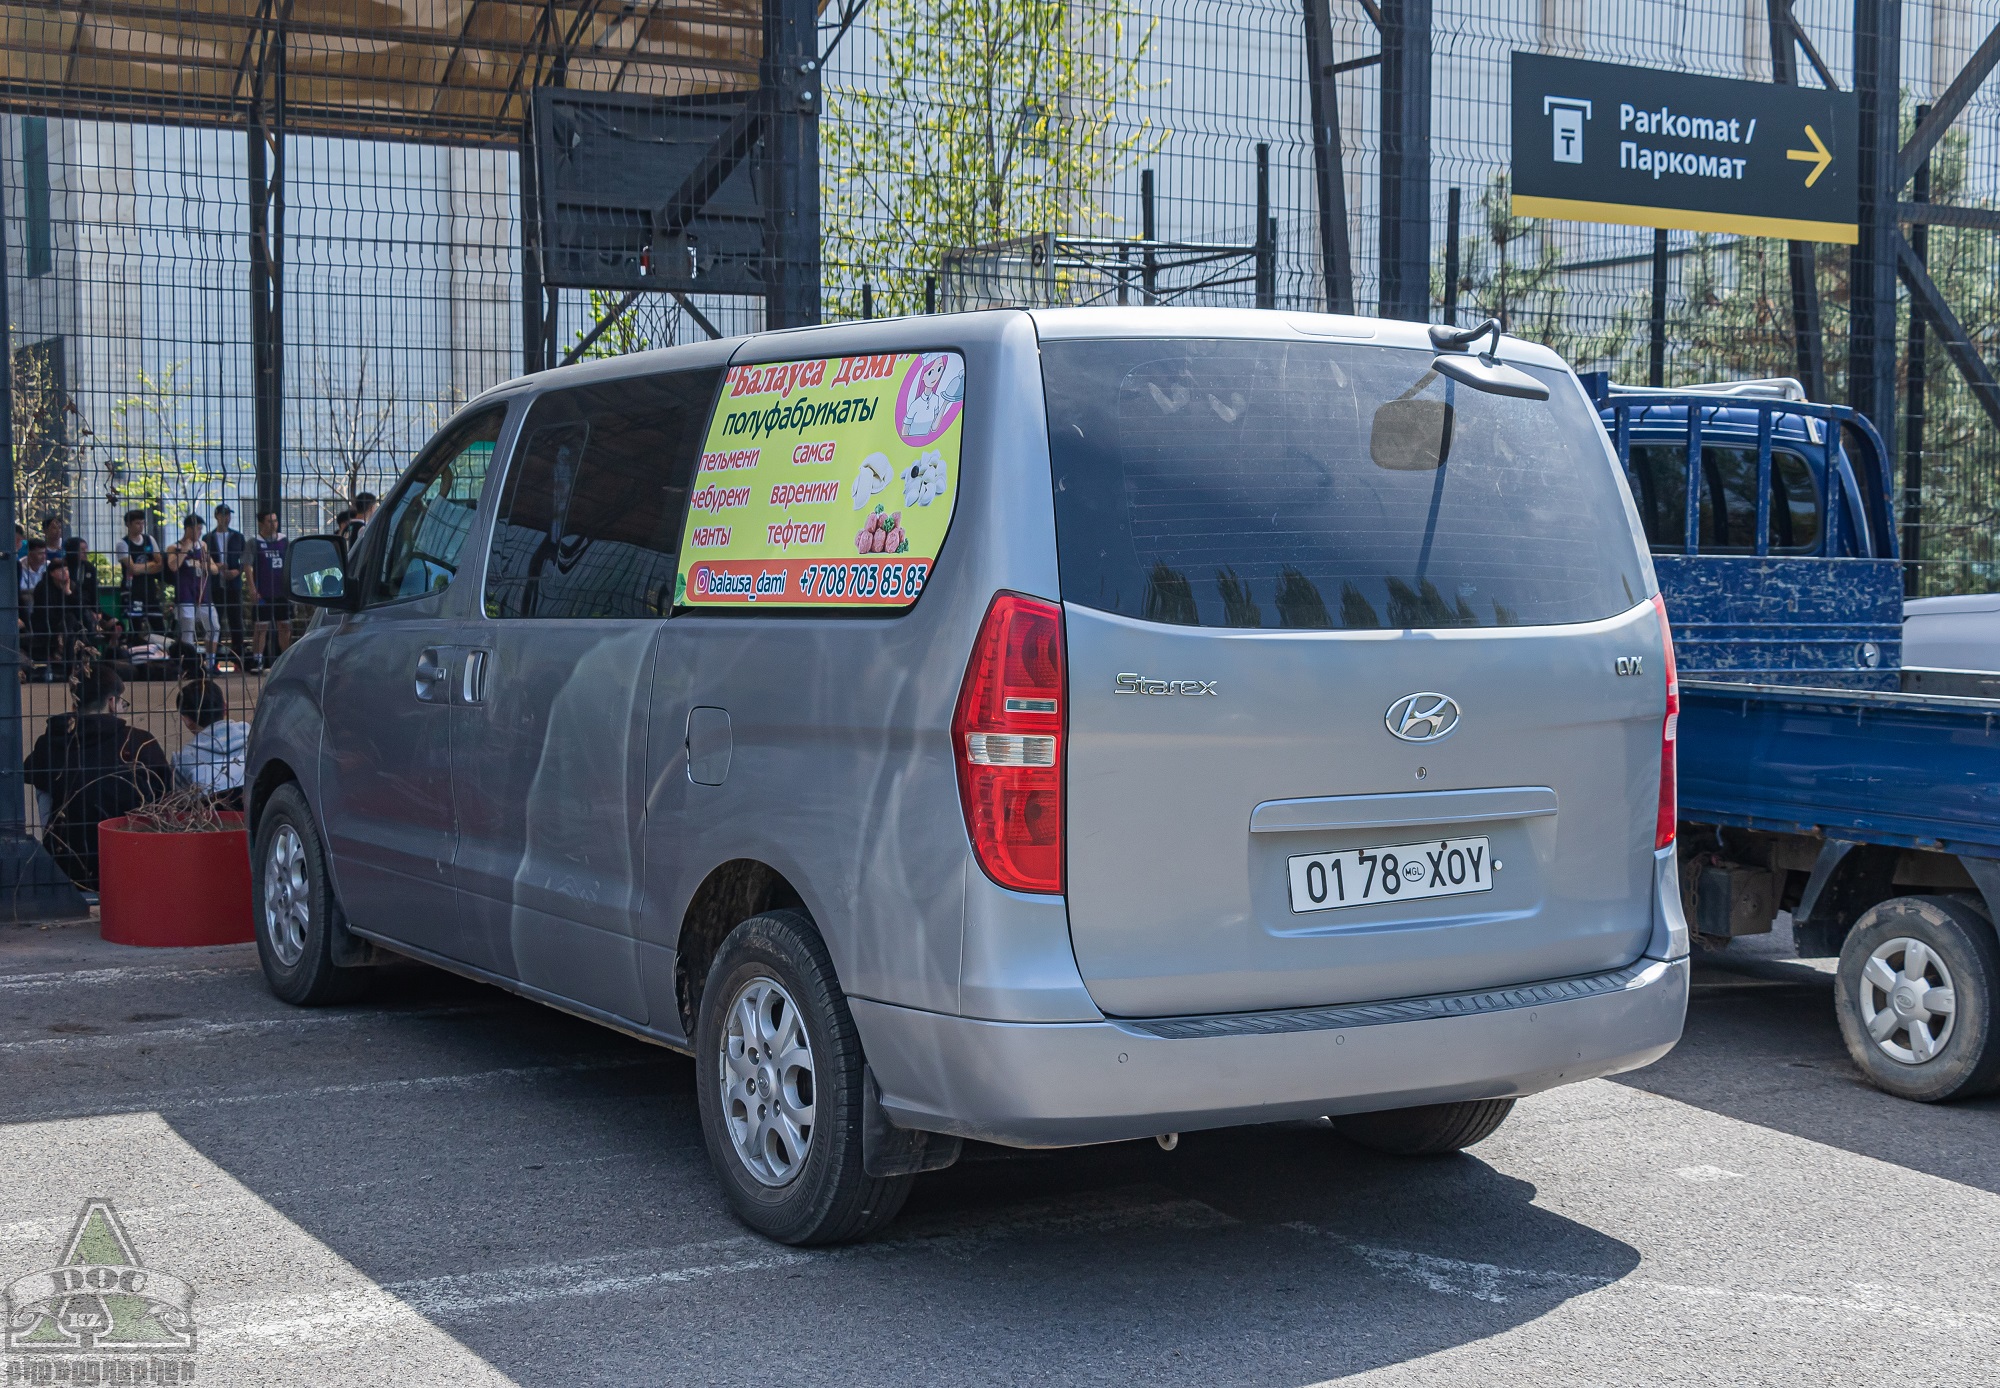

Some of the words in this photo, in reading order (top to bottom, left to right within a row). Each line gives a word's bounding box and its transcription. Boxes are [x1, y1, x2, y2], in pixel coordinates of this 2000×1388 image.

[1619, 103, 1741, 144] Parkomat
[1744, 118, 1757, 145] /
[1619, 141, 1747, 181] Паркомат
[722, 396, 880, 440] полуфабрикаты
[699, 448, 761, 472] пельмени
[792, 442, 836, 465] самса
[769, 481, 839, 510] вареники
[690, 526, 732, 547] манты
[767, 518, 826, 550] тефтели
[709, 569, 787, 600] balausa_dami
[1615, 656, 1644, 676] CVX
[1113, 672, 1218, 696] Starex
[1405, 866, 1422, 877] MGL
